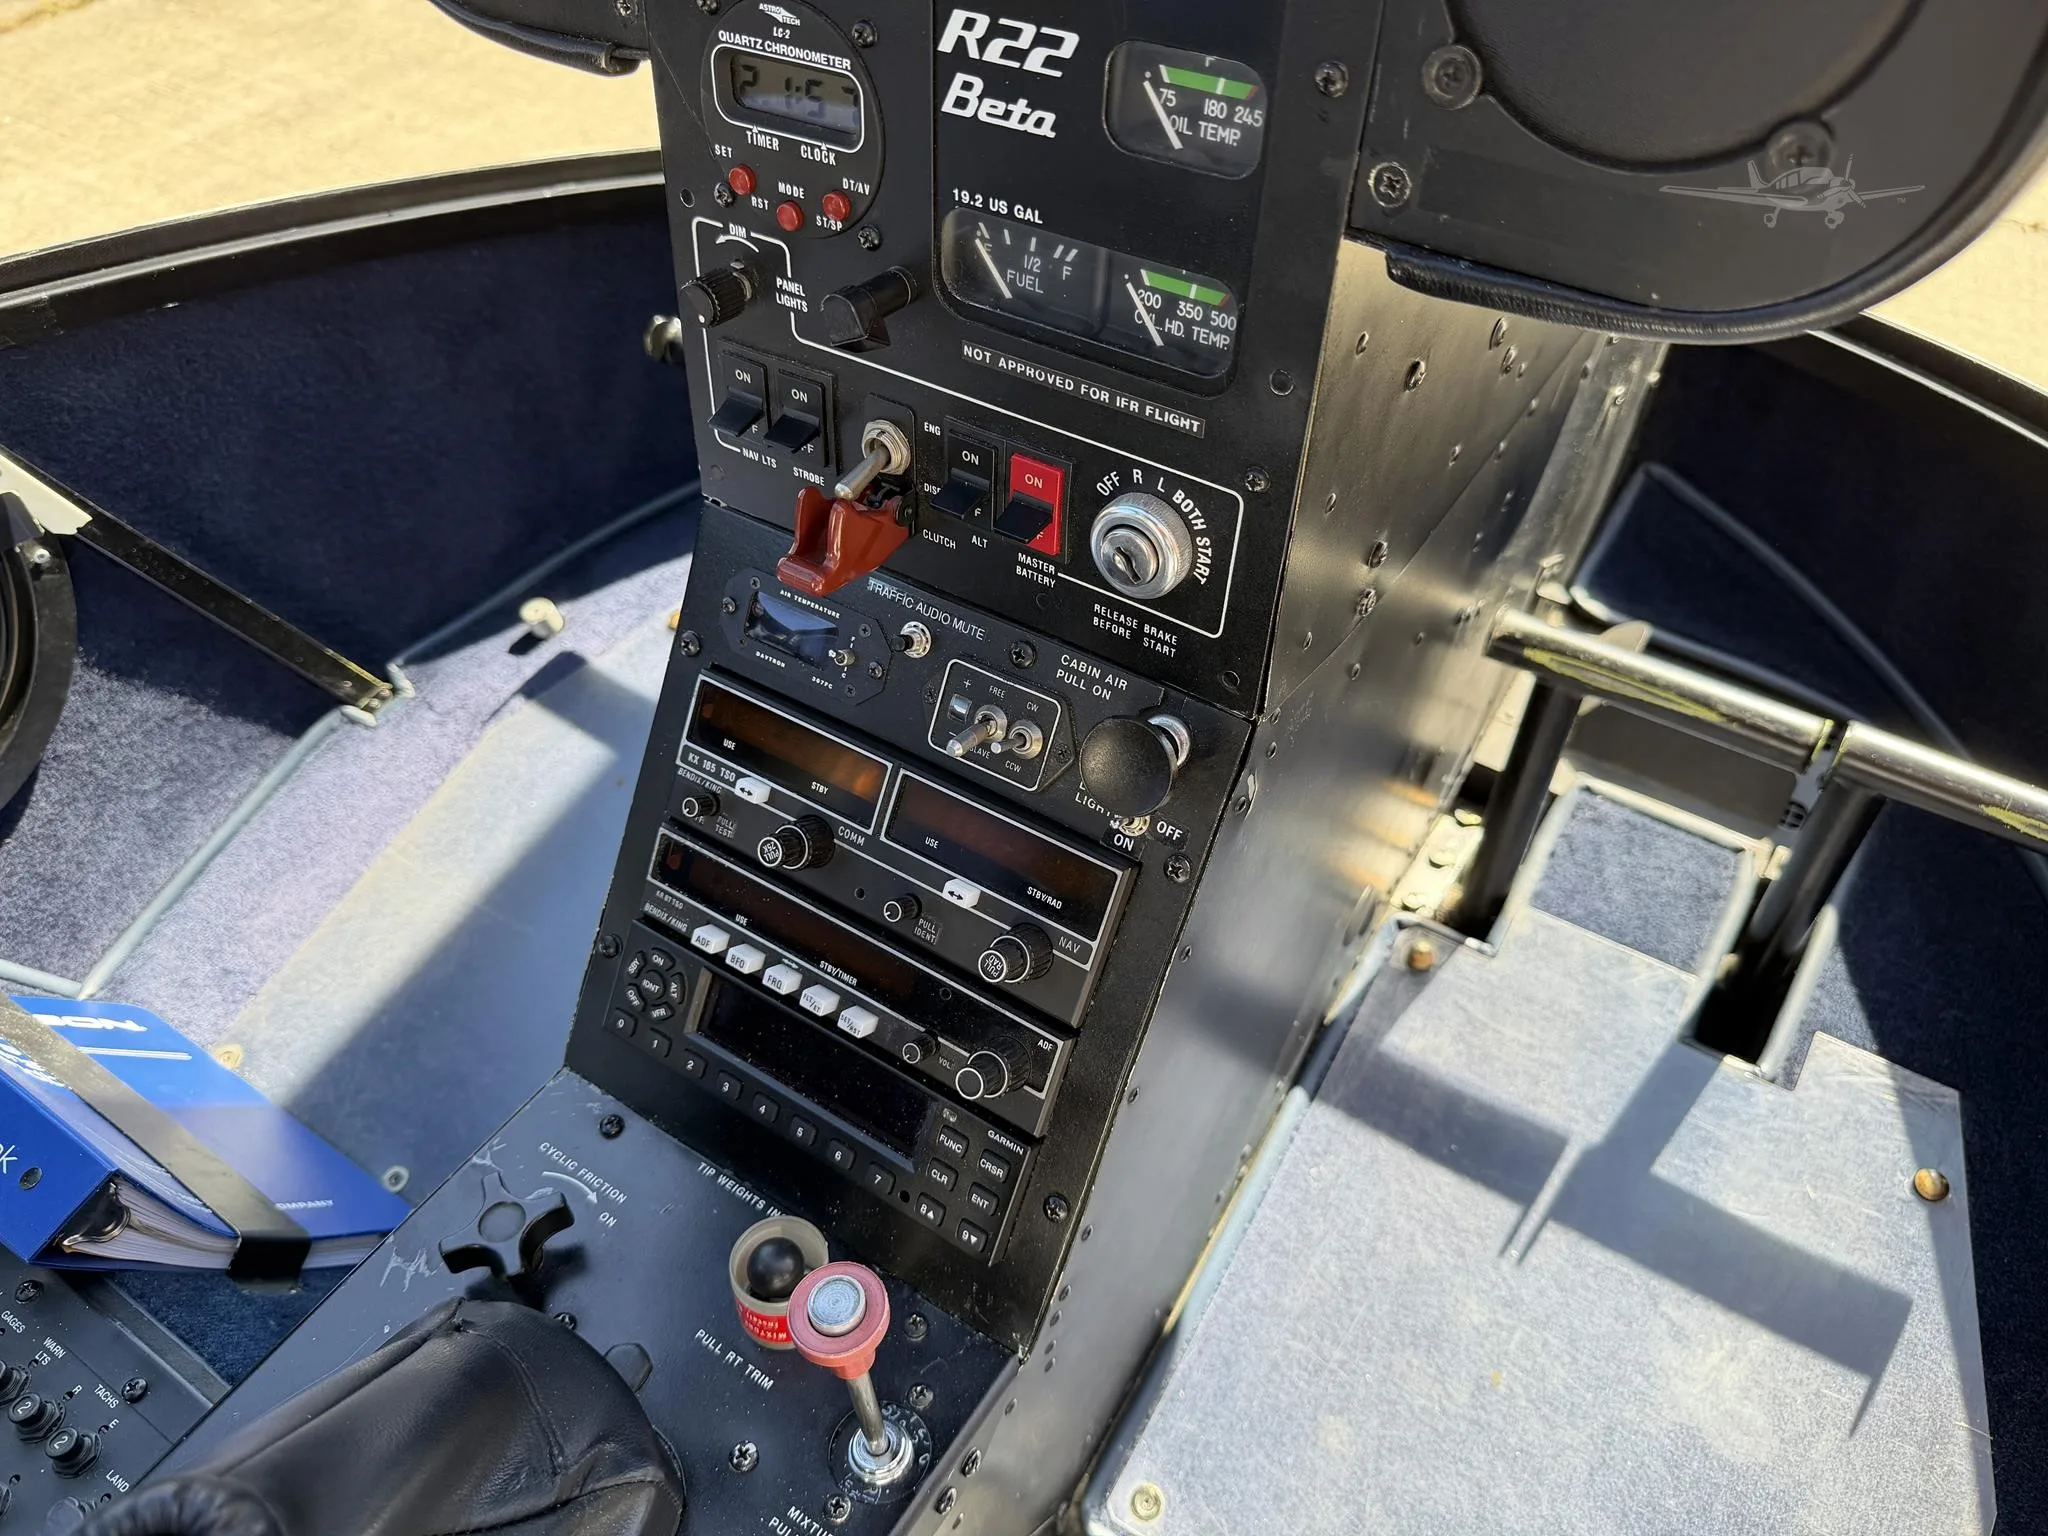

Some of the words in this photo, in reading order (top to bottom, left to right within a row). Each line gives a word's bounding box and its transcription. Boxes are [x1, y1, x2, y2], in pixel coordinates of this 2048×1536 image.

[759, 3, 781, 14] ASTRO
[782, 16, 800, 26] TECH
[718, 30, 763, 50] QUARTZ
[764, 40, 851, 70] CHRONOMETER
[937, 8, 1080, 78] R22
[941, 72, 1057, 139] Beta
[1159, 88, 1177, 107] 75
[1203, 98, 1228, 119] 180
[1233, 106, 1263, 127] 245
[1168, 115, 1193, 136] OIL
[1198, 120, 1242, 147] TEMP.
[746, 131, 780, 151] TIMER
[714, 145, 732, 158] SET
[800, 145, 836, 166] CLOCK
[778, 182, 805, 200] MODE
[843, 178, 870, 196] DT/AV
[751, 196, 769, 210] RST
[952, 187, 984, 208] 19.2
[989, 198, 1009, 215] US
[1014, 205, 1043, 225] GAL
[729, 223, 747, 239] DIM
[816, 216, 843, 231] ST/SP
[1024, 254, 1041, 273] 1/2
[1062, 266, 1073, 281] F
[776, 278, 806, 297] PANEL
[1006, 269, 1044, 294] FUEL
[776, 292, 808, 313] LIGHTS
[1137, 289, 1162, 309] 200
[1176, 301, 1203, 321] 350
[1210, 310, 1237, 331] 500
[1165, 318, 1185, 338] HD.
[1191, 325, 1230, 351] TEMP.
[735, 369, 751, 383] ON
[791, 388, 808, 403] ON
[963, 344, 992, 364] NOT
[998, 356, 1075, 392] APPROVED
[1080, 383, 1110, 403] FOR
[1116, 395, 1140, 414] IFR
[1145, 405, 1201, 433] FLIGHT
[924, 421, 941, 436] ENG
[742, 447, 759, 462] NAV
[761, 454, 777, 469] LTS
[962, 450, 979, 466] ON
[793, 466, 825, 487] STROBE
[1024, 473, 1043, 489] ON
[1096, 471, 1121, 497] OFF
[1132, 469, 1143, 484] R
[1157, 477, 1166, 492] L
[1172, 490, 1207, 531] BOTH
[1193, 536, 1212, 586] START
[922, 529, 956, 550] CLUTCH
[971, 535, 988, 549] ALT
[1018, 552, 1055, 575] MASTER
[1016, 566, 1056, 589] BATTERY
[780, 589, 792, 599] AIR
[794, 595, 840, 619] TEMPERATURE
[868, 580, 914, 609] TRAFFIC
[915, 602, 951, 625] AUDIO
[952, 617, 986, 641] MUTE
[1094, 604, 1138, 630] RELEASE
[1144, 624, 1178, 646] BRAKE
[1093, 616, 1132, 641] BEFORE
[1143, 637, 1176, 659] START
[755, 651, 786, 668] DAYTRON
[1060, 654, 1101, 680] CABIN
[1104, 672, 1129, 691] AIR
[988, 685, 1006, 699] FREE
[1056, 669, 1087, 691] PULL
[1092, 685, 1112, 701] ON
[1026, 701, 1039, 712] CW
[723, 738, 736, 750] USE
[688, 753, 700, 765] KX
[703, 760, 717, 773] 165
[720, 767, 736, 782] TSO
[1005, 760, 1022, 773] CCW
[677, 767, 722, 794] BENDIX/KING
[811, 781, 829, 795] STBY
[715, 824, 732, 838] TEST
[717, 815, 734, 830] PULL
[1156, 820, 1183, 841] OFF
[838, 826, 865, 846] COMM
[925, 836, 938, 848] USE
[1113, 833, 1134, 852] ON
[1027, 886, 1063, 909] STBY/RAD
[644, 902, 688, 932] BENDIX/KING
[735, 913, 748, 927] USE
[918, 918, 935, 934] PULL
[696, 935, 711, 948] ADF
[914, 926, 936, 943] IDENT
[1058, 936, 1081, 954] NAV
[628, 957, 640, 975] SBY
[652, 954, 664, 966] ON
[730, 954, 745, 969] BFO
[819, 960, 858, 987] STBY/TIMER
[642, 979, 660, 993] IDNT
[670, 982, 678, 998] ALT
[627, 990, 640, 1006] OFF
[652, 1007, 666, 1018] VFR
[652, 1039, 658, 1049] 1
[1037, 1038, 1054, 1051] ADF
[686, 1060, 694, 1070] 2
[938, 1056, 951, 1070] VOL
[722, 1081, 729, 1092] 3
[758, 1104, 766, 1115] 4
[796, 1127, 803, 1137] 5
[939, 1134, 963, 1153] FUNC
[987, 1129, 1024, 1156] GARMIN
[835, 1150, 842, 1161] 6
[539, 1142, 578, 1171] CYCLIC
[577, 1163, 628, 1204] FRICTION
[931, 1168, 949, 1185] CLR
[980, 1158, 1004, 1178] CRSR
[697, 1161, 717, 1177] TIP
[717, 1174, 766, 1209] WEIGHTS
[874, 1174, 882, 1185] 7
[920, 1203, 927, 1214] 8
[971, 1193, 990, 1210] ENT
[599, 1211, 618, 1229] ON
[961, 1229, 969, 1240] 9
[1, 1310, 26, 1334] GAGES
[43, 1337, 67, 1359] WARN
[35, 1350, 52, 1366] LTS
[695, 1328, 722, 1356] PULL
[725, 1350, 745, 1367] RT
[745, 1364, 775, 1391] TRIM
[71, 1384, 83, 1396] R
[93, 1383, 119, 1409] TACHS
[17, 1400, 31, 1415] 2
[108, 1418, 119, 1429] E
[53, 1435, 69, 1449] 2
[106, 1469, 130, 1493] LAND
